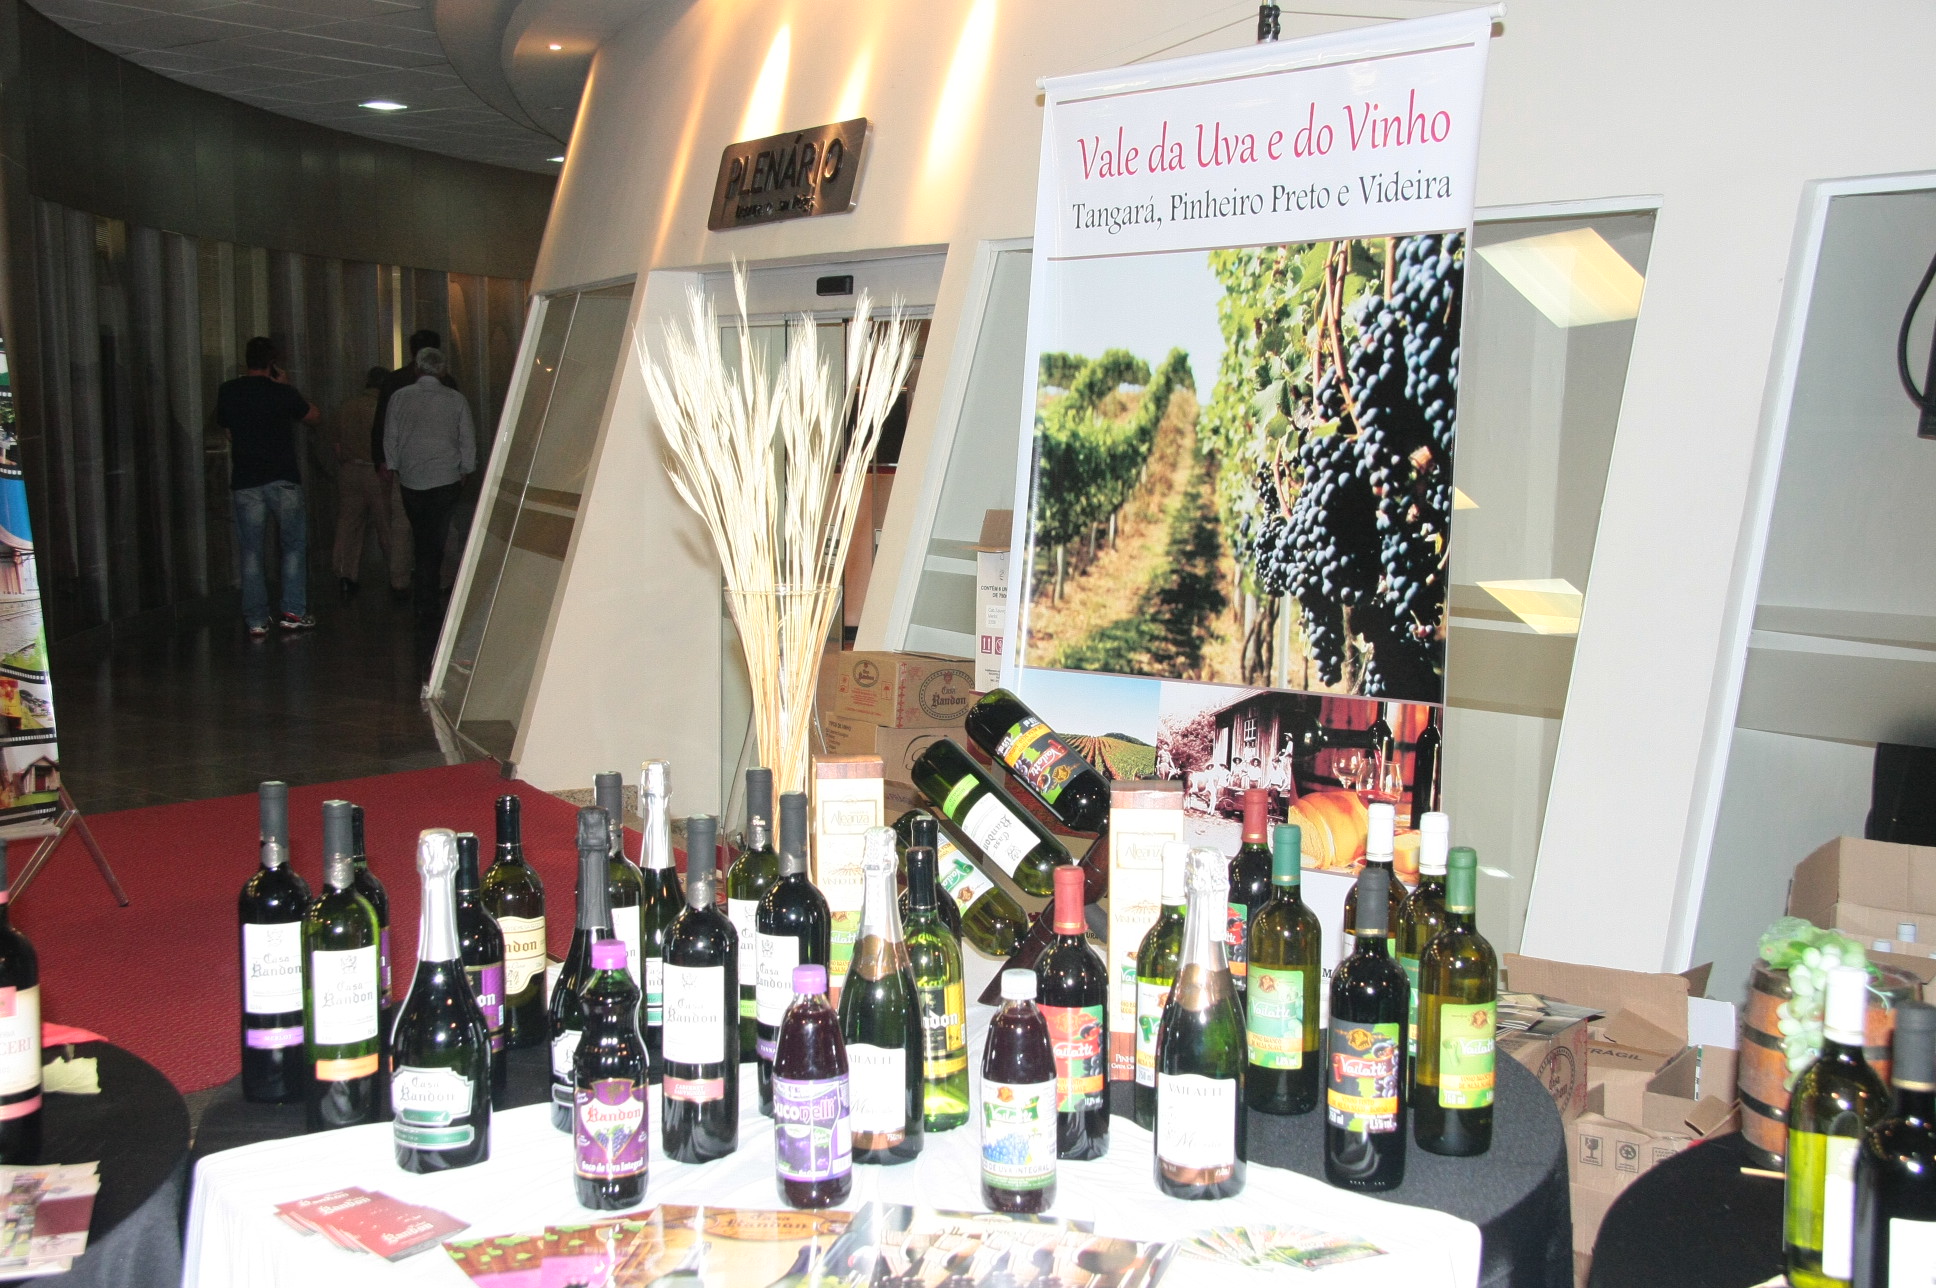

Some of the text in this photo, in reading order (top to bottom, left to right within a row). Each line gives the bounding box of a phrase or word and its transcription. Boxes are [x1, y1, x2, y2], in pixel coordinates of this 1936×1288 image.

[1076, 88, 1452, 180] Vale da Uva e do Vinho
[725, 133, 844, 199] PLENÁRIO
[1072, 169, 1453, 236] Tangará, Pinheiro Preto e Videira
[931, 692, 967, 708] Randon
[1029, 746, 1061, 777] Vailatti
[982, 812, 1012, 852] Randon
[992, 830, 1011, 850] Casa
[940, 867, 967, 890] Vaila
[741, 927, 753, 938] Ca
[506, 940, 538, 953] ndon
[263, 953, 290, 964] Casa
[251, 960, 302, 979] Randon
[760, 962, 779, 975] Casa
[336, 980, 363, 992] Casa
[322, 991, 374, 1009] Randon
[1251, 998, 1291, 1019] Vailatti
[666, 1004, 717, 1024] Randon
[922, 1008, 958, 1030] ndon
[760, 1046, 776, 1054] TANNA
[1340, 1055, 1387, 1077] Vailatti
[399, 1081, 455, 1102] Randon
[411, 1076, 440, 1089] Casa
[586, 1105, 641, 1123] Randon
[581, 1160, 597, 1172] Suco
[597, 1162, 606, 1172] de
[621, 1157, 644, 1171] Integral
[1015, 1164, 1050, 1175] INTEGRAL
